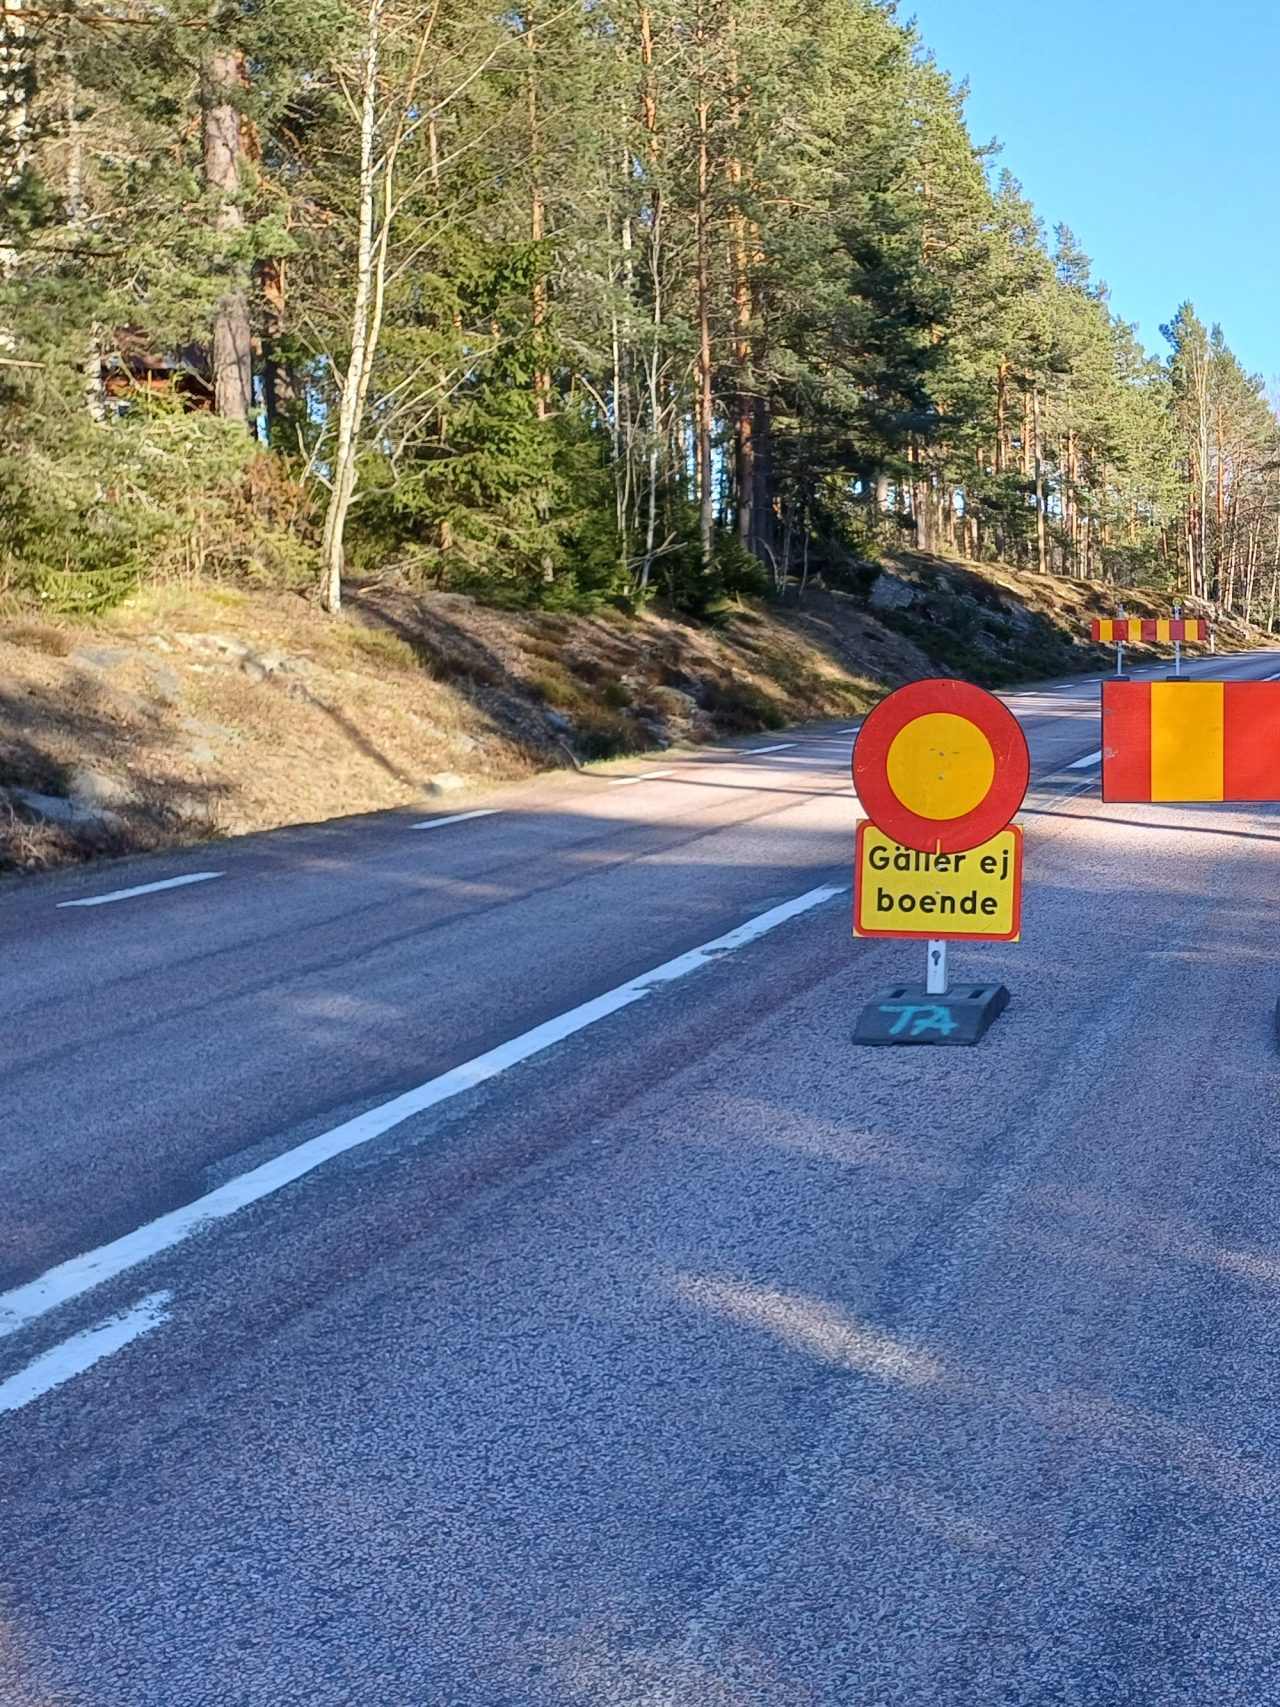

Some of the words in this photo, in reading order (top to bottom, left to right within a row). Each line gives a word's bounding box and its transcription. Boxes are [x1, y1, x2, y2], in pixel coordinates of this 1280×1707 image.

[868, 845, 966, 873] Gäller
[980, 849, 1009, 881] ej
[877, 887, 998, 916] boende
[879, 1005, 959, 1036] TA
